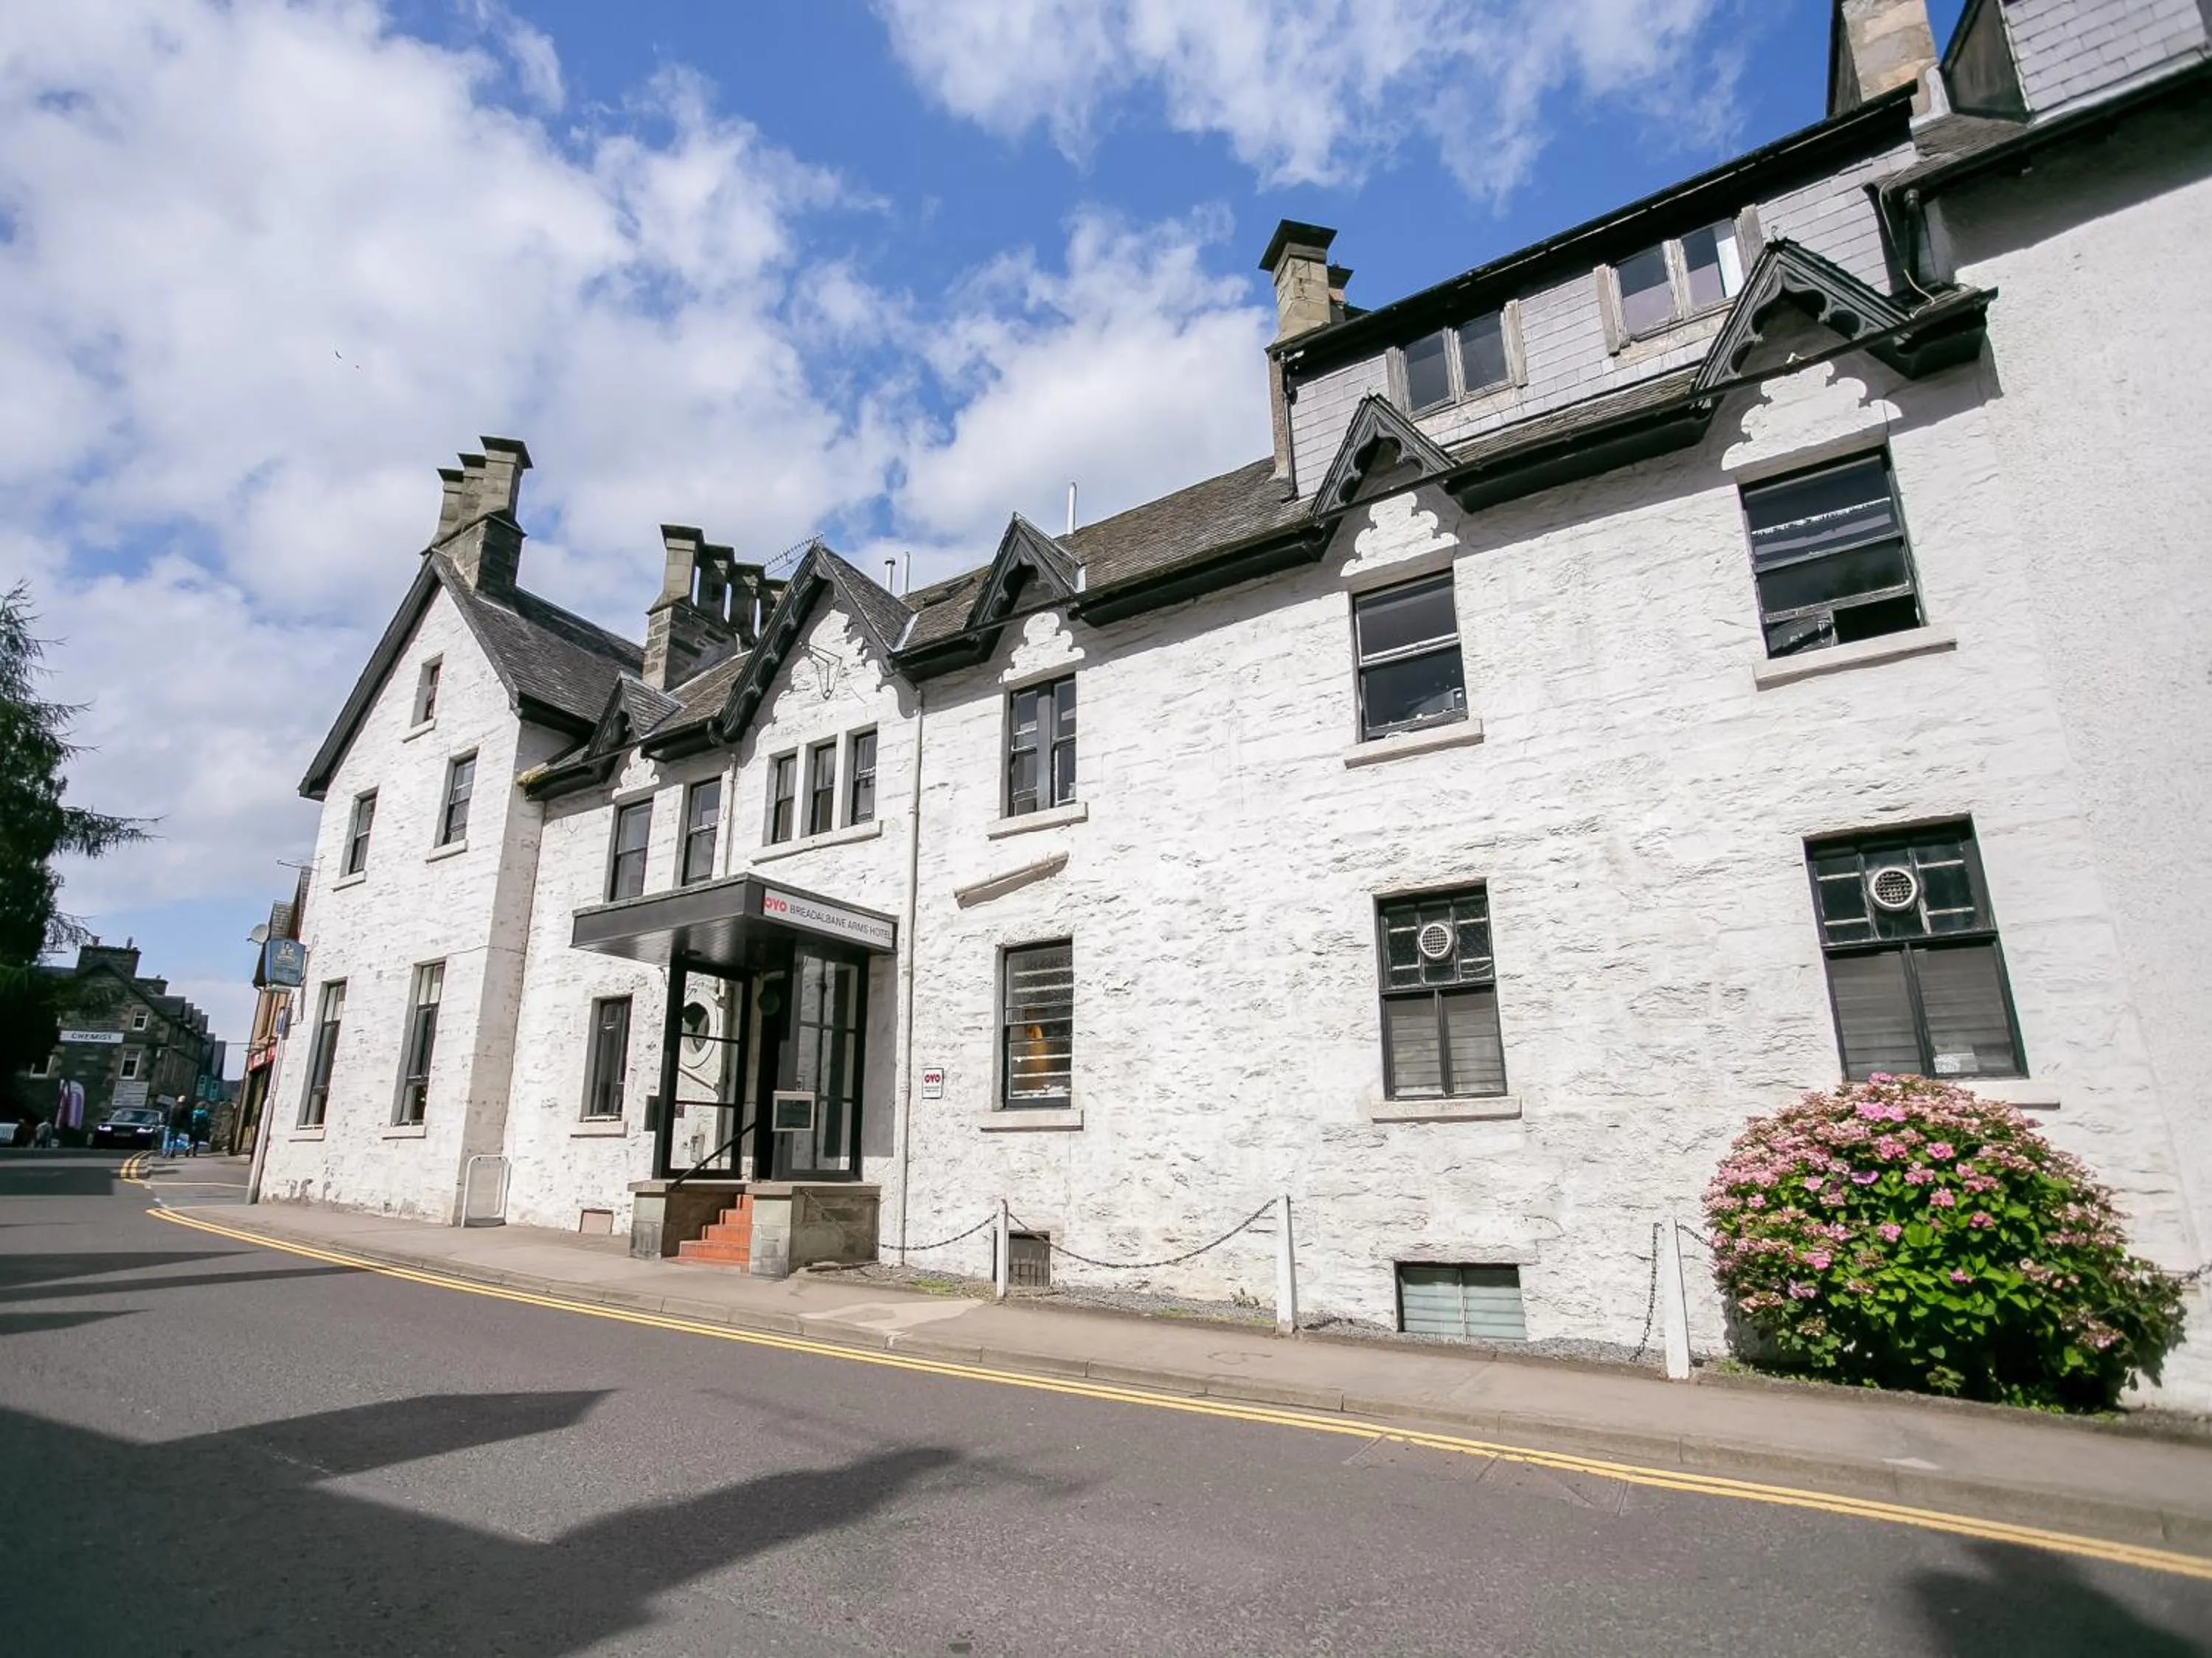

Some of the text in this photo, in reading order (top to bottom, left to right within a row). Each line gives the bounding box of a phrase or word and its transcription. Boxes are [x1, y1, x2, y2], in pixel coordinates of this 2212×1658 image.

[762, 896, 892, 940] OYO BREADALBANE ARMS HOTEL
[71, 1033, 112, 1041] CHEMIST
[924, 1073, 941, 1083] OYO
